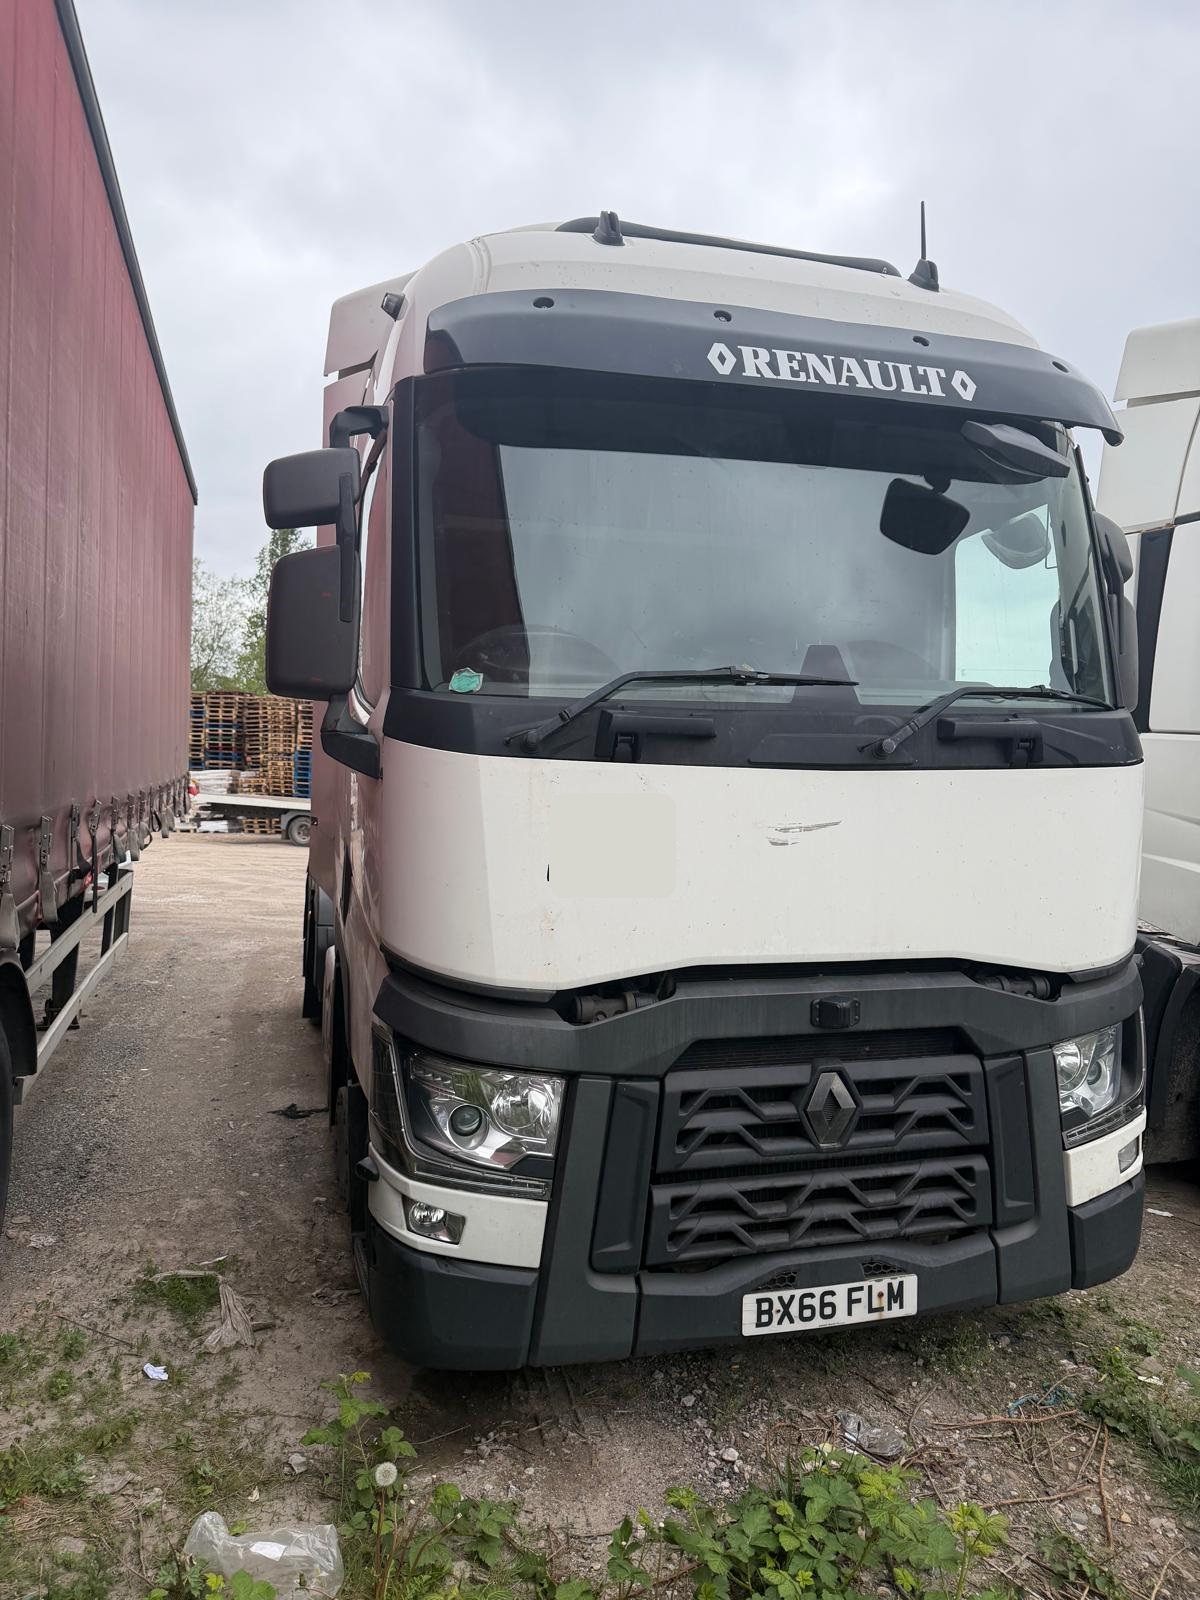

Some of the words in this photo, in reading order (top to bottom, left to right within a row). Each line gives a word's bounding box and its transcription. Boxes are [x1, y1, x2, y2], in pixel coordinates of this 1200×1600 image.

[738, 346, 946, 397] RENAULT
[755, 1290, 837, 1328] BX66
[847, 1280, 904, 1317] FLM
